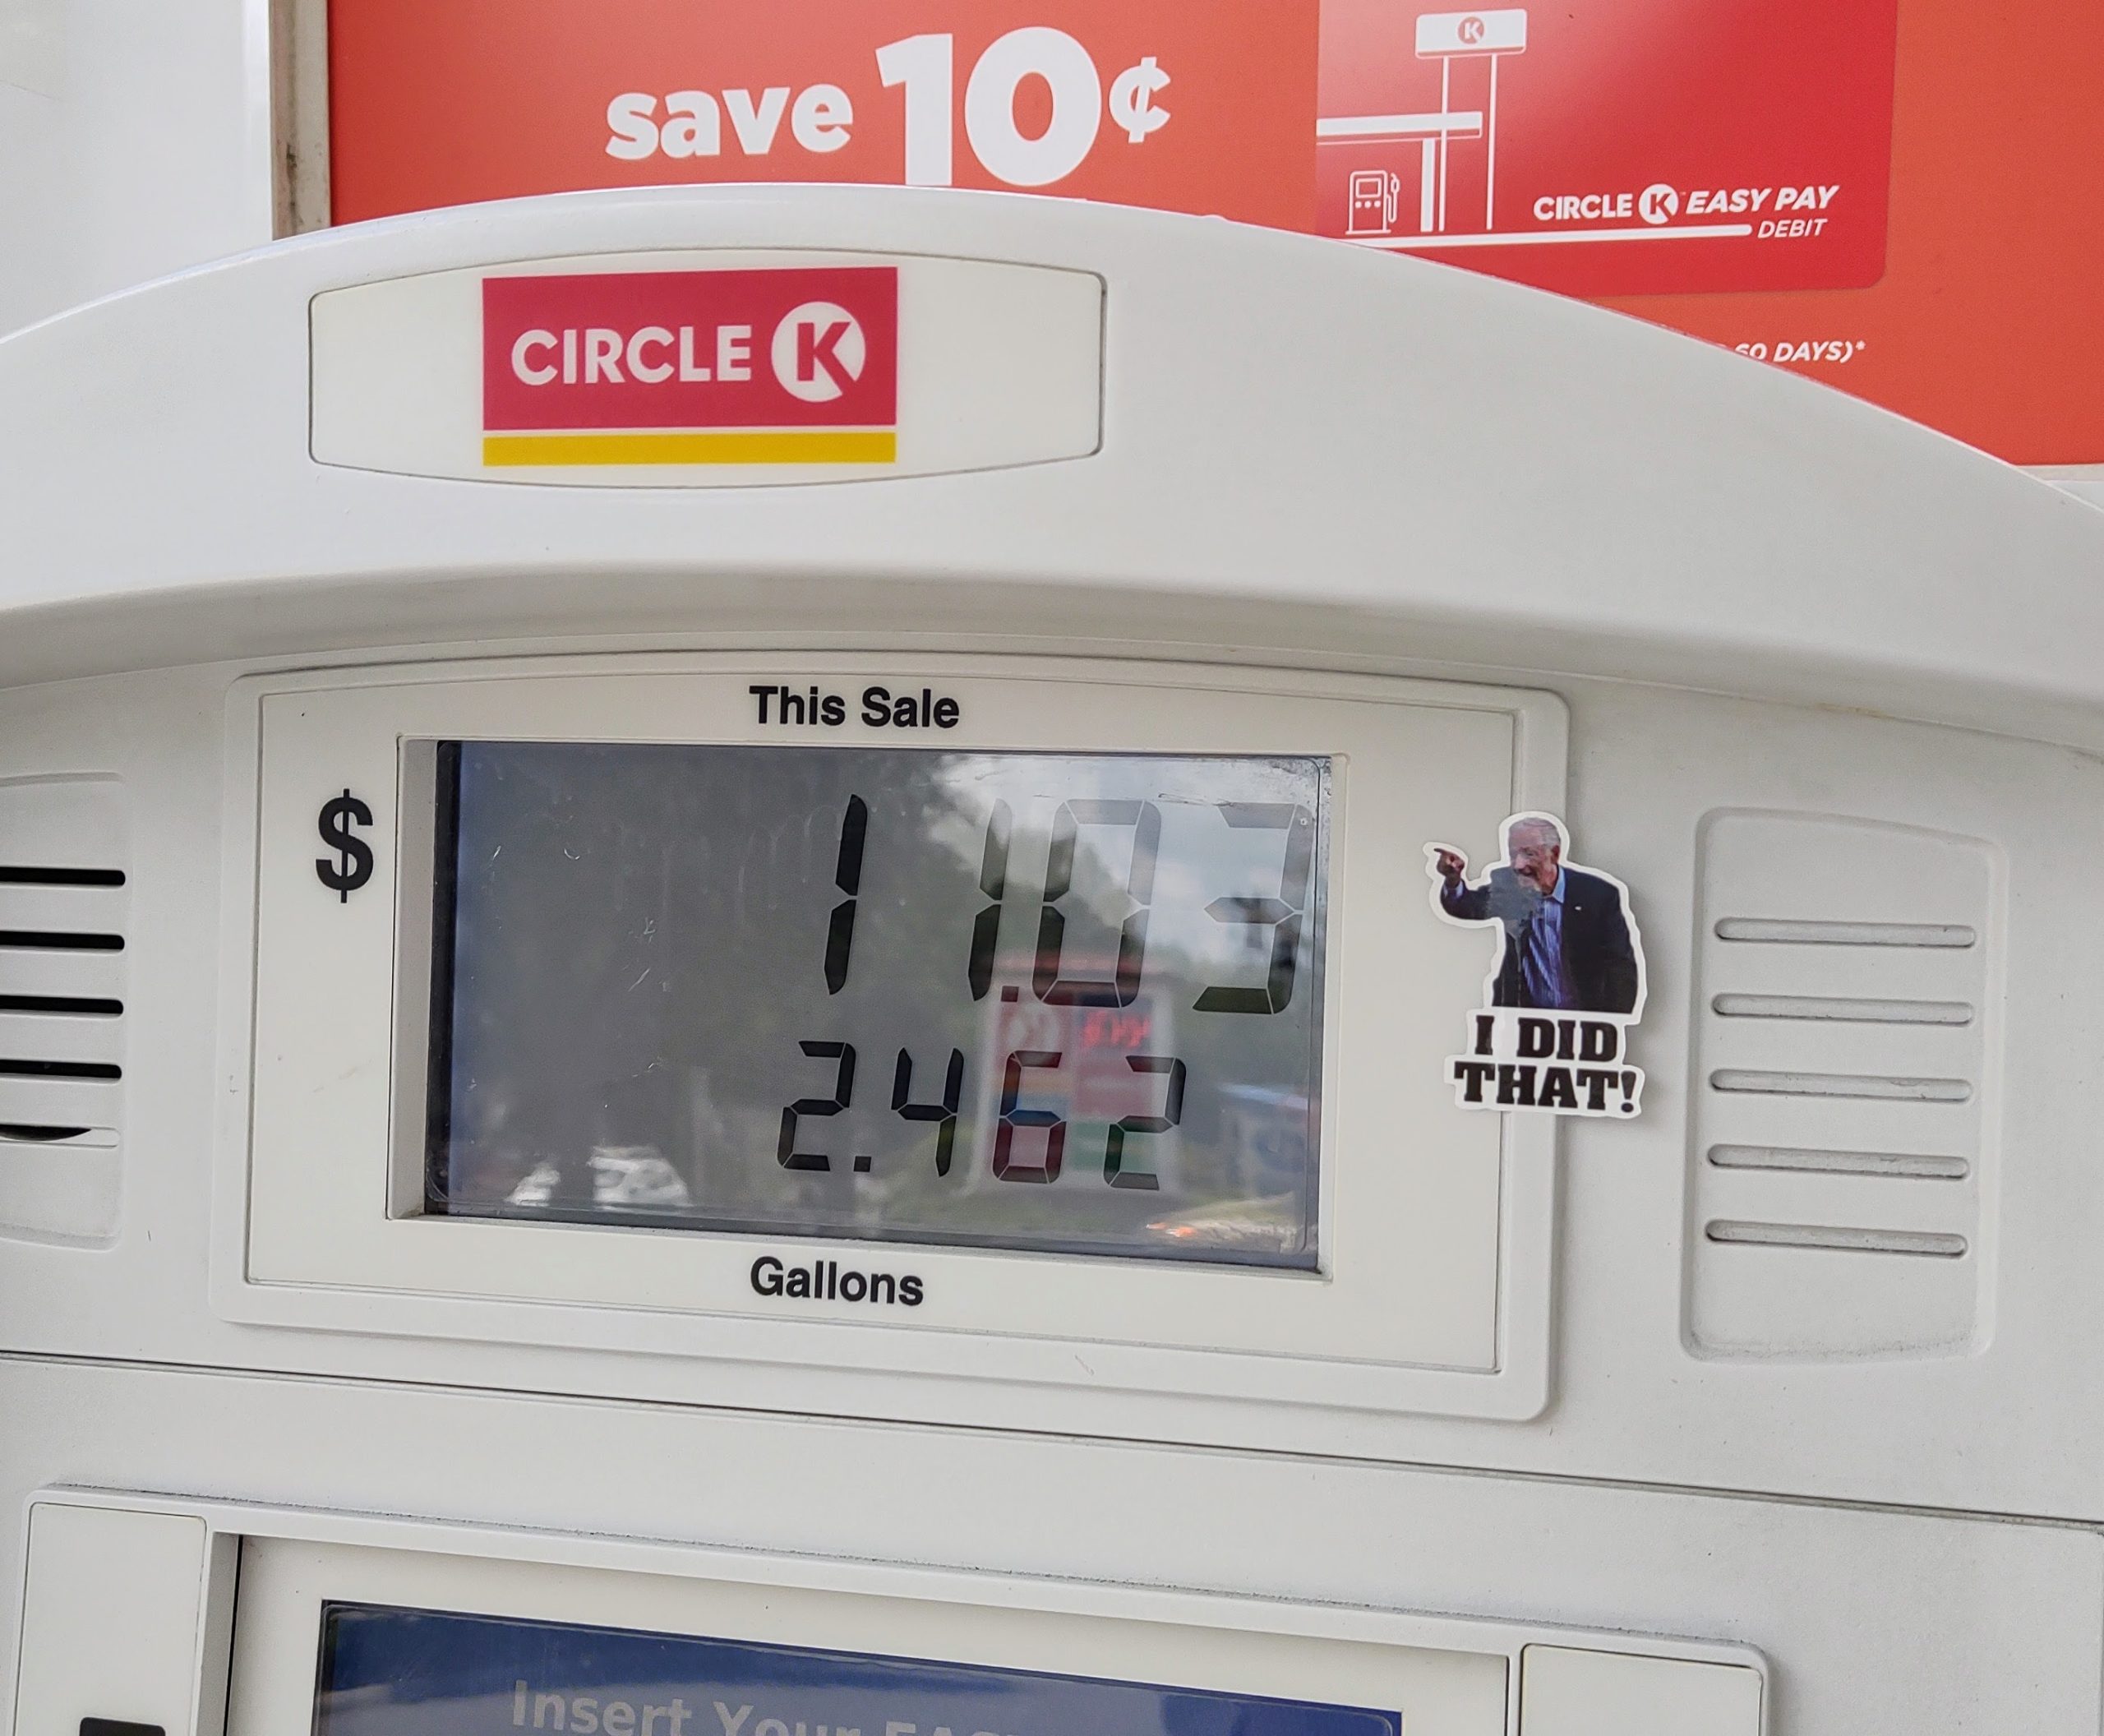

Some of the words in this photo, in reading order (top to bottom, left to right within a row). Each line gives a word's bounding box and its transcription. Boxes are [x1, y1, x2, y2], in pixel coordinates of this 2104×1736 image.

[606, 83, 853, 160] save
[1533, 193, 1633, 221] CIRCLE
[1646, 189, 1677, 222] K
[1686, 187, 1773, 215] EASY
[1774, 185, 1840, 211] PAY
[1757, 218, 1829, 239] DEBIT
[511, 326, 752, 386] CIRCLE
[789, 314, 862, 398] K
[749, 686, 846, 726] This
[861, 686, 960, 729] Sale
[316, 788, 374, 903] $
[1474, 1014, 1494, 1055] I
[1516, 1017, 1618, 1062] DID
[1454, 1061, 1636, 1113] THAT!
[777, 1041, 1186, 1191] 2.462
[750, 1256, 924, 1307] Gallons
[513, 1679, 692, 1736] Insert
[713, 1701, 861, 1736] Yo
